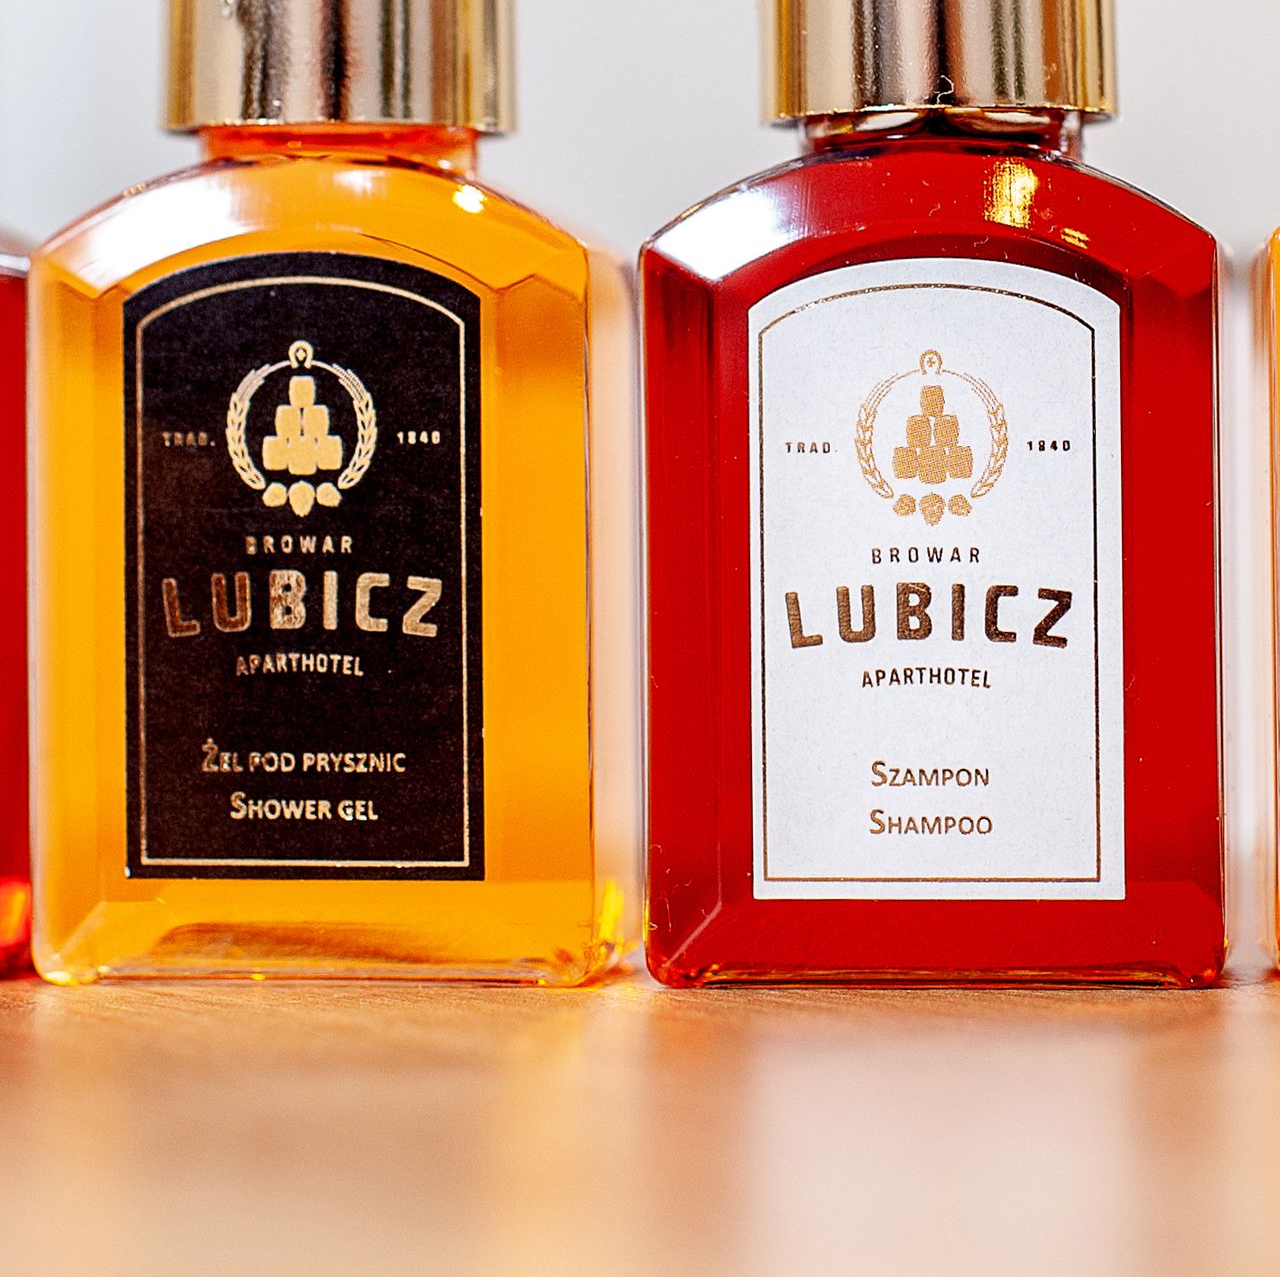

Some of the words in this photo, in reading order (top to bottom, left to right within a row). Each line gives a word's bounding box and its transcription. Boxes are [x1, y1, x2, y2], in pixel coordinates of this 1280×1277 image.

[785, 441, 838, 454] TRAD.
[1026, 440, 1071, 452] 1840
[245, 535, 353, 554] BROWAR
[871, 546, 981, 564] BROWAR
[161, 570, 443, 638] LUBICZ
[784, 581, 1073, 649] LUBICZ
[236, 653, 364, 676] APARTHOTEL
[861, 667, 991, 688] APARTHOTEL
[248, 752, 296, 773] POD
[302, 752, 406, 773] PRYSZNIC
[871, 760, 990, 787] SZAMPON
[230, 791, 332, 820] SHOWER
[337, 800, 379, 821] GEL
[869, 808, 993, 834] SHAMPOO
